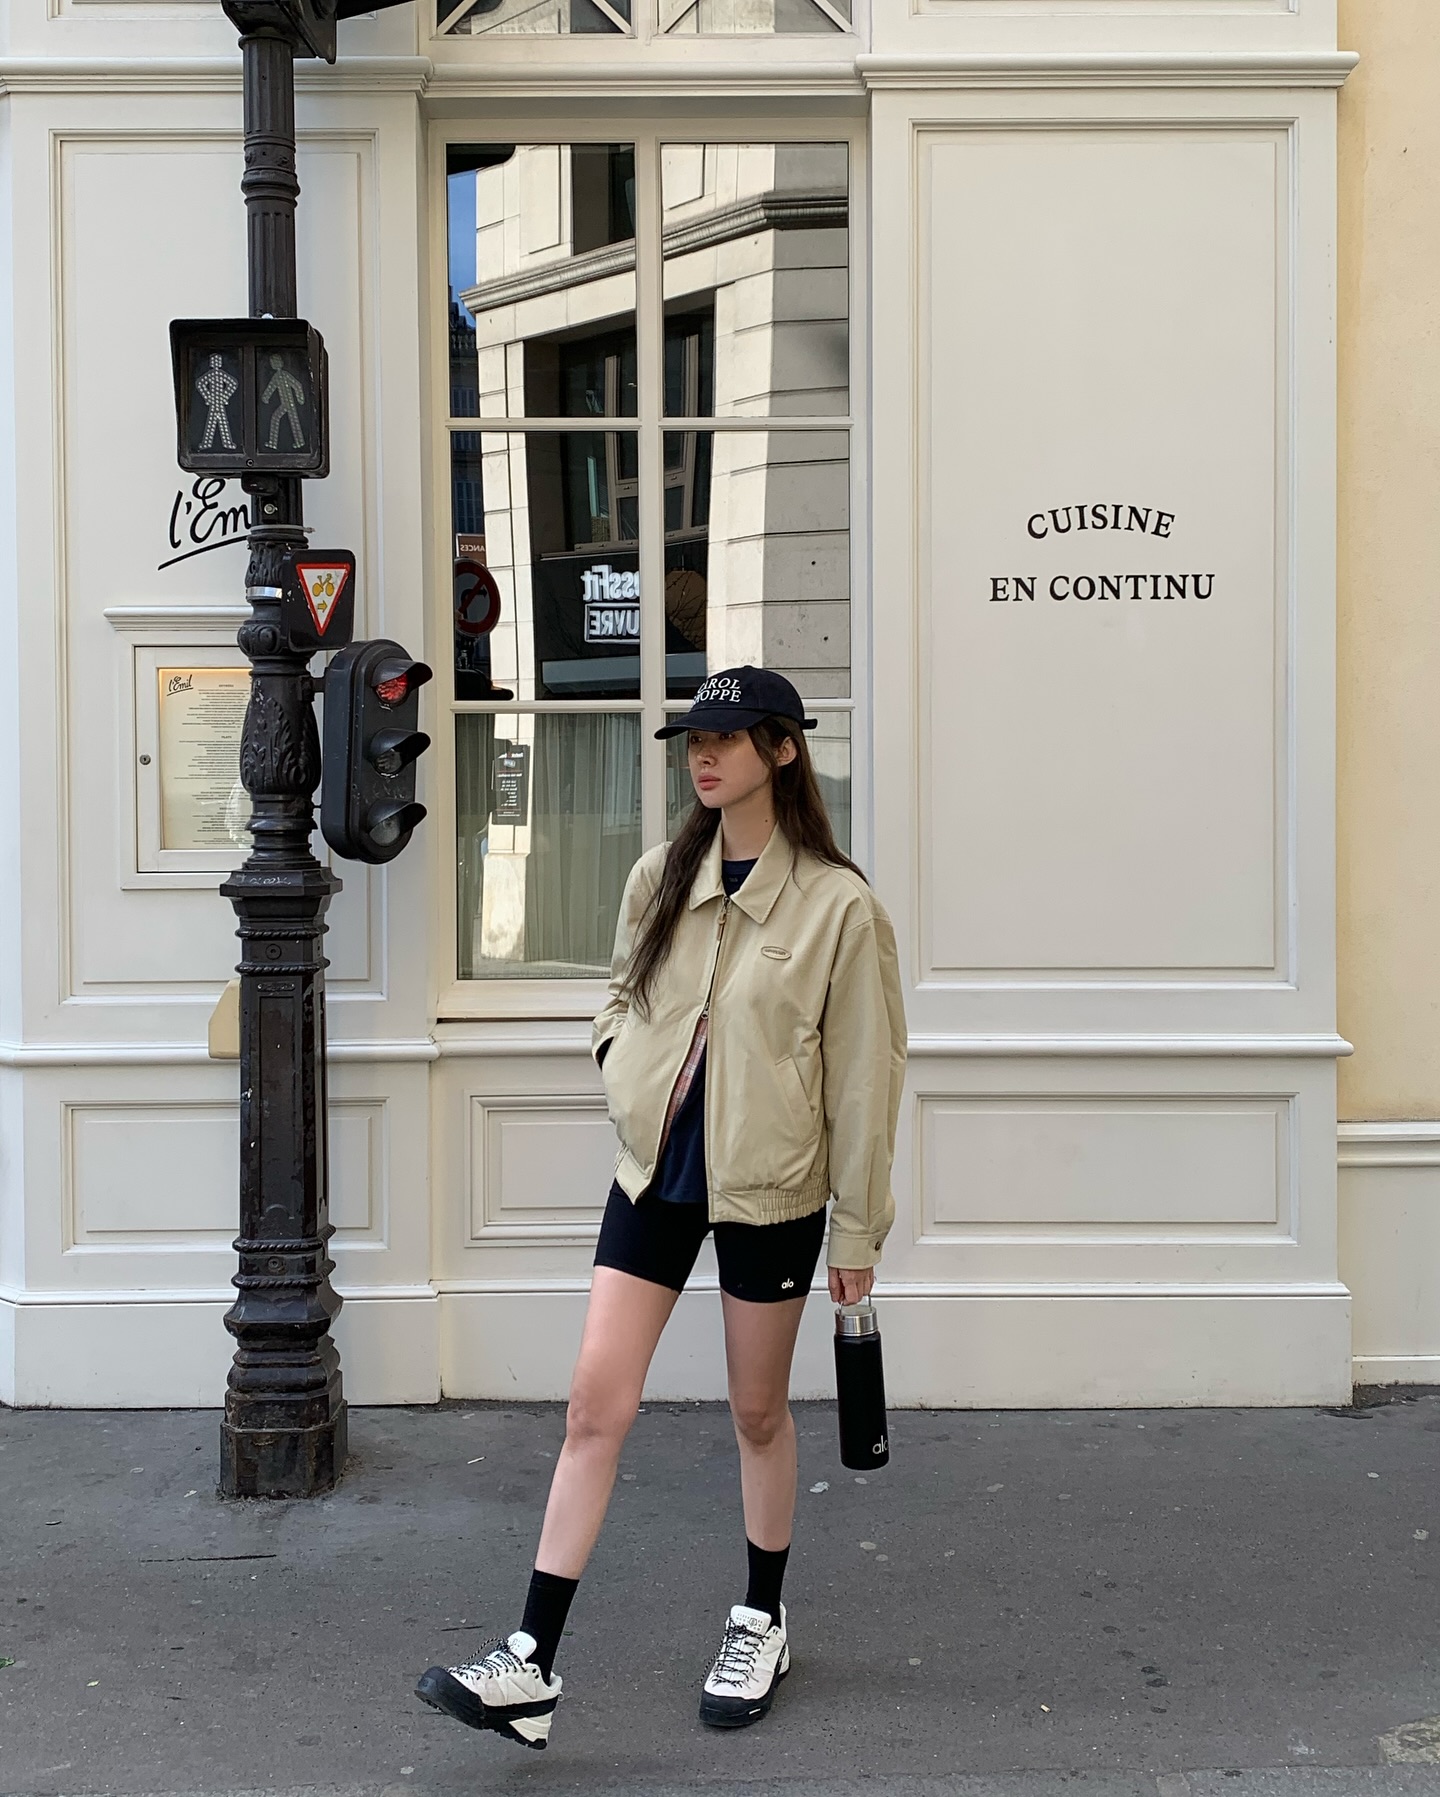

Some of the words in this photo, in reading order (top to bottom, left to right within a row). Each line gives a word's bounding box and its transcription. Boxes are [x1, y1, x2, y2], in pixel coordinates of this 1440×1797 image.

[168, 477, 251, 550] l'Em
[1027, 503, 1176, 540] CUISINE
[989, 576, 1037, 602] EN
[1049, 573, 1216, 601] CONTINU
[781, 1278, 794, 1289] alo
